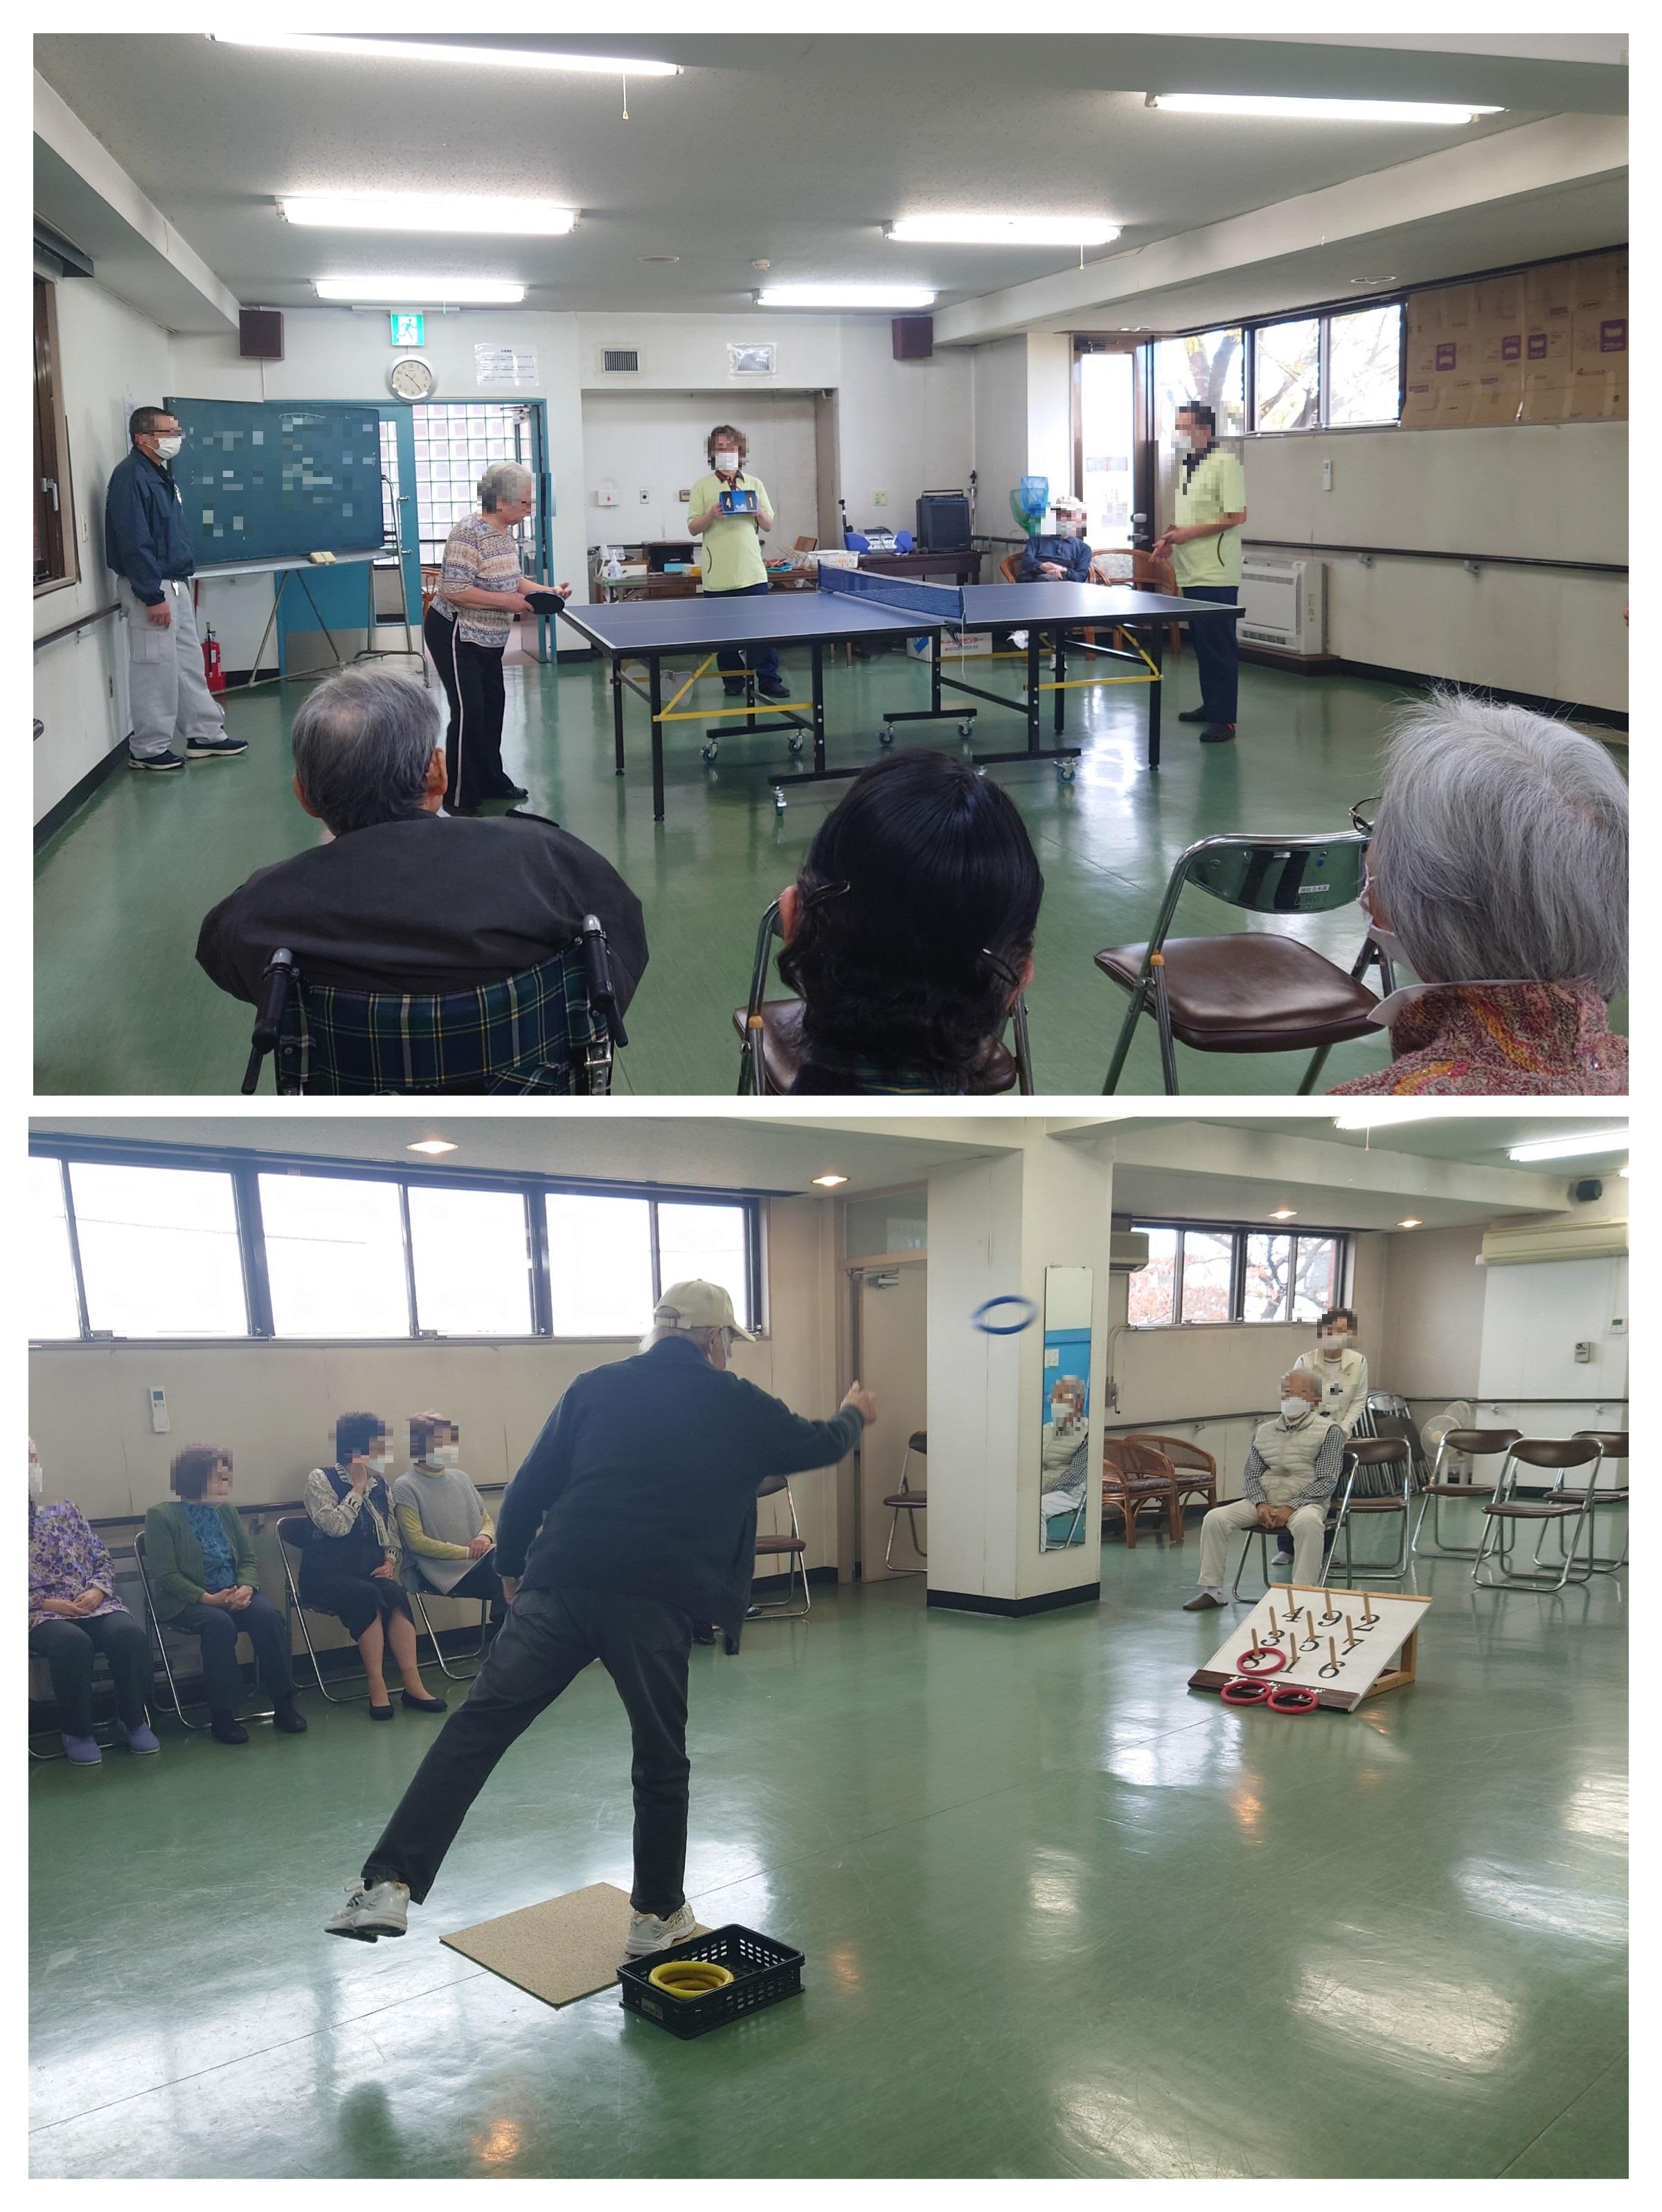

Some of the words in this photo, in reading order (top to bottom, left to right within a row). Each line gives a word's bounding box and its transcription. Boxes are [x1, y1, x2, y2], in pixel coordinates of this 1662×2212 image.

[726, 498, 731, 508] 4
[749, 497, 753, 507] 1
[1281, 1606, 1305, 1623] 4
[1317, 1610, 1343, 1627] 9
[1352, 1614, 1381, 1632] 2
[1260, 1630, 1285, 1646] 3
[1299, 1635, 1324, 1652] 5
[1341, 1638, 1366, 1655] 7
[1242, 1653, 1266, 1669] 8
[1280, 1657, 1301, 1674] 1
[1318, 1661, 1346, 1679] 6
